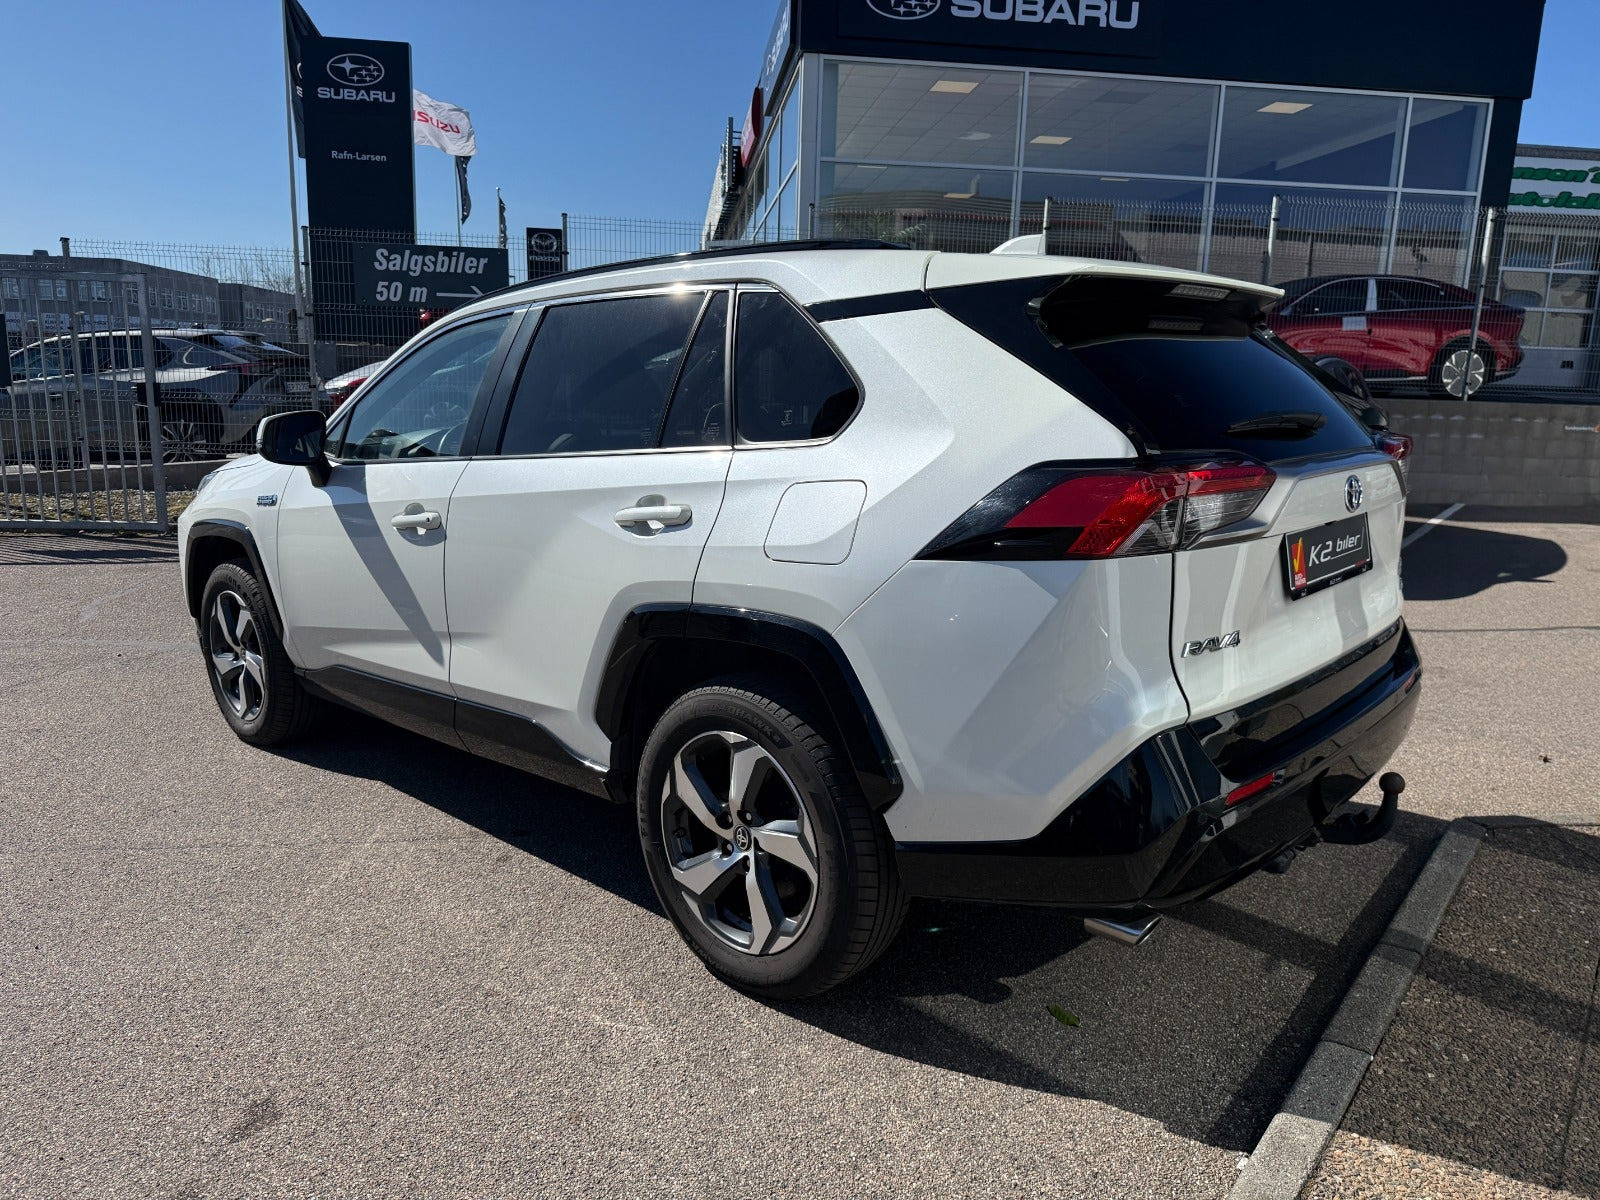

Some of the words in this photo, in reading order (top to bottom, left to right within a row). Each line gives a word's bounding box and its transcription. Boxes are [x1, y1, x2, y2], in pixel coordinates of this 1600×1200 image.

[950, 0, 1140, 30] SUBARU
[317, 86, 396, 103] SUBARU
[331, 150, 387, 163] Rafn-Larsen
[373, 248, 489, 277] Salgsbiler
[375, 280, 403, 302] 50
[408, 285, 428, 303] m
[1308, 540, 1333, 567] K2
[1336, 534, 1361, 553] biler
[1180, 630, 1241, 658] RAV4
